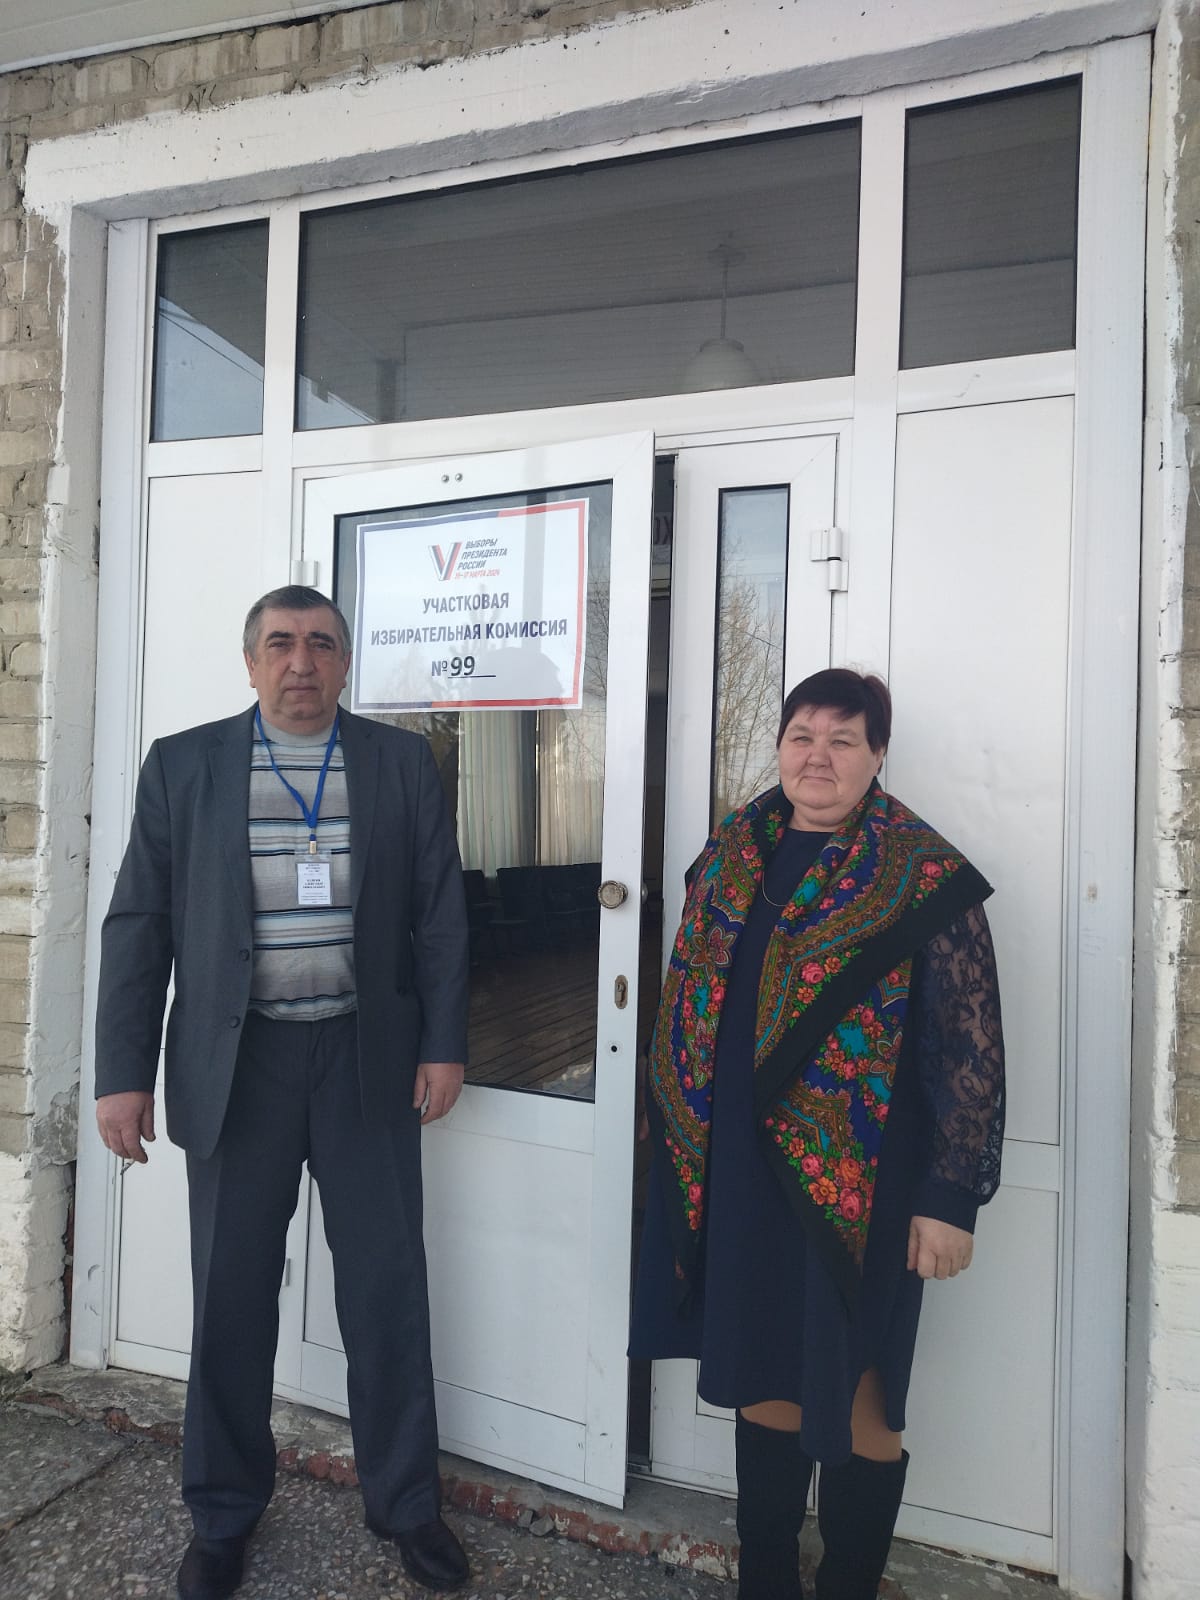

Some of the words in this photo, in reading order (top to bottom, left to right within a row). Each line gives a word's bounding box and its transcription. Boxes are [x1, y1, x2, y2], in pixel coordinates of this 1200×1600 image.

[465, 538, 498, 549] ВЫБОРЫ
[461, 548, 507, 559] ПРЕЗИДЕНТА
[457, 560, 486, 570] РОССИИ
[423, 592, 509, 614] УЧАСТКОВАЯ
[371, 624, 481, 645] ИЗБИРАТЕЛЬНАЯ
[485, 619, 568, 640] КОМИССИЯ
